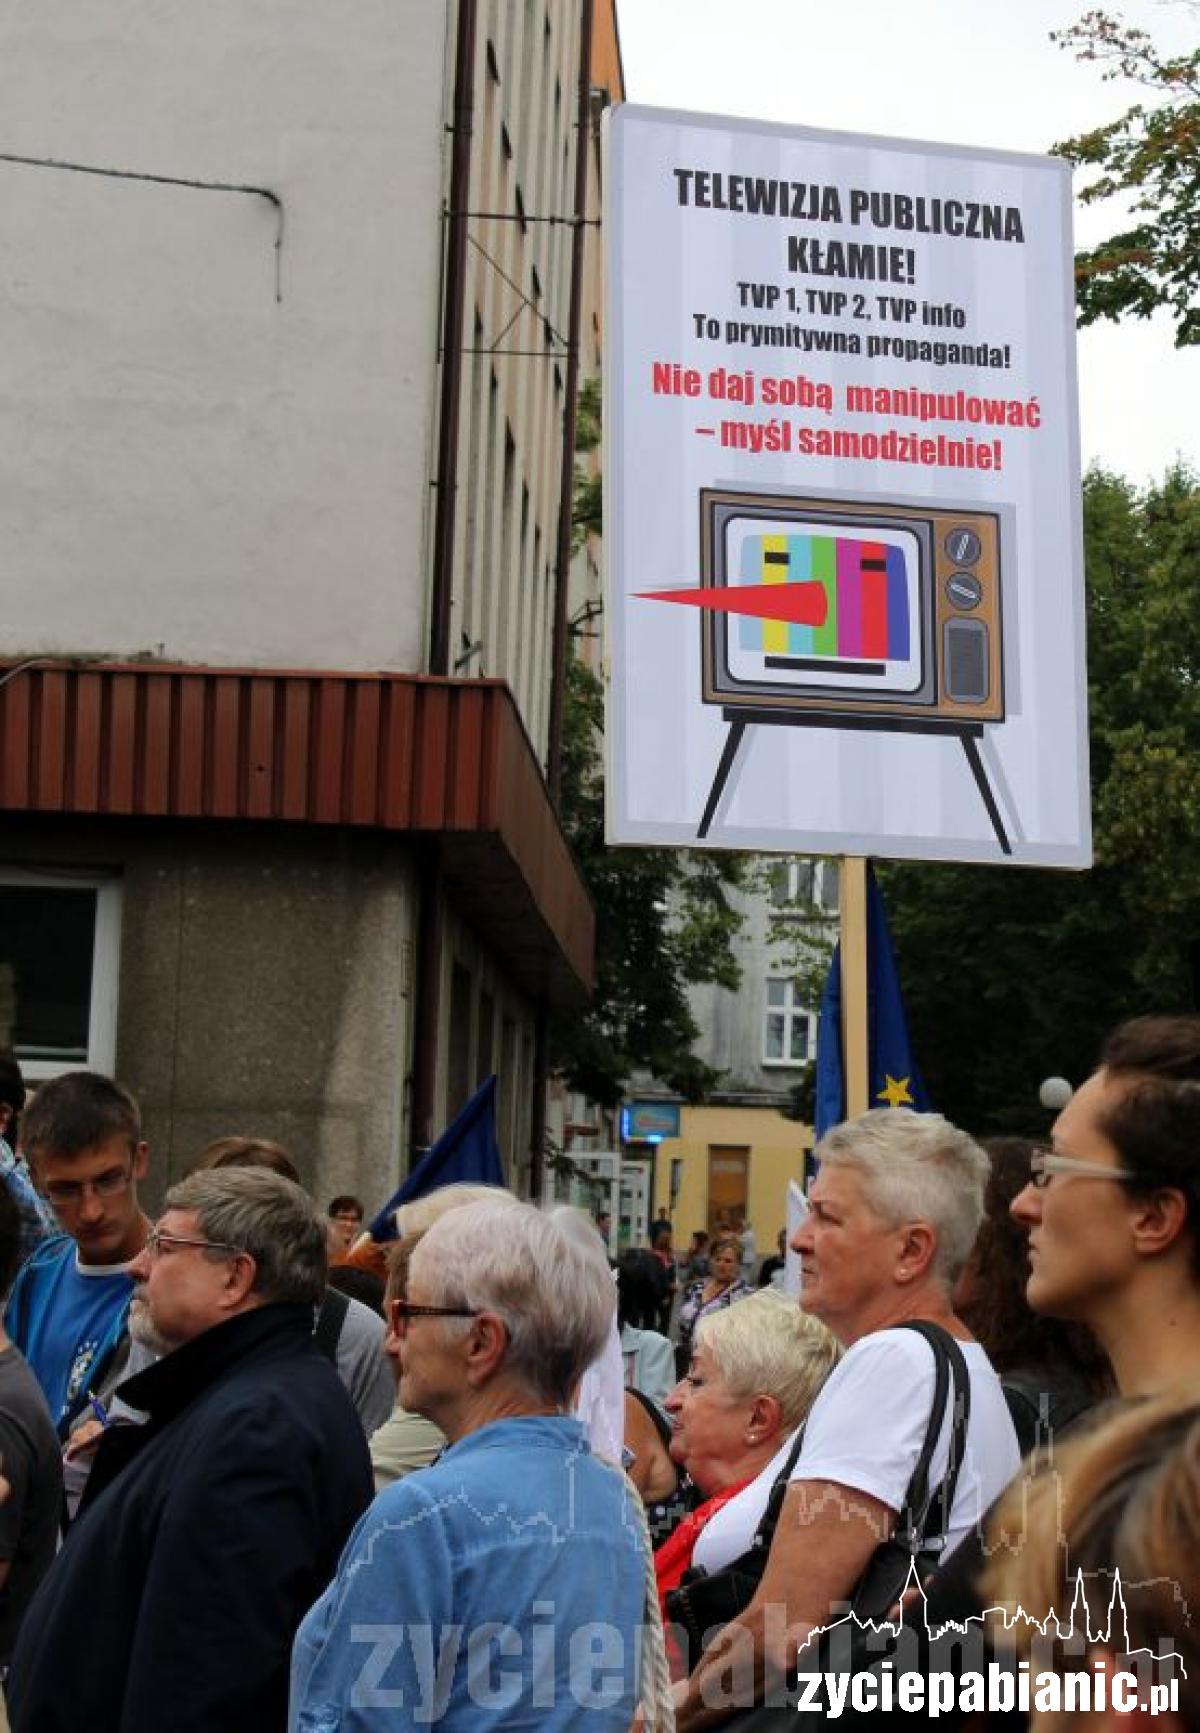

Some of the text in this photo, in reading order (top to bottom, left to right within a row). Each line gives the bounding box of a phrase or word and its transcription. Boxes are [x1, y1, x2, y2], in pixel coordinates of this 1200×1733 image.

[673, 168, 1025, 243] TELEWIZJA PUBLICZNA
[787, 235, 915, 284] KŁAMIE!
[737, 281, 967, 329] TVP 1, TVP 2, TVP info
[692, 313, 1011, 369] To prymitywna propaganda!
[653, 361, 1042, 428] Nie daj sobą manipulować
[720, 417, 792, 454] myśl
[798, 427, 1002, 471] samodzielnie!
